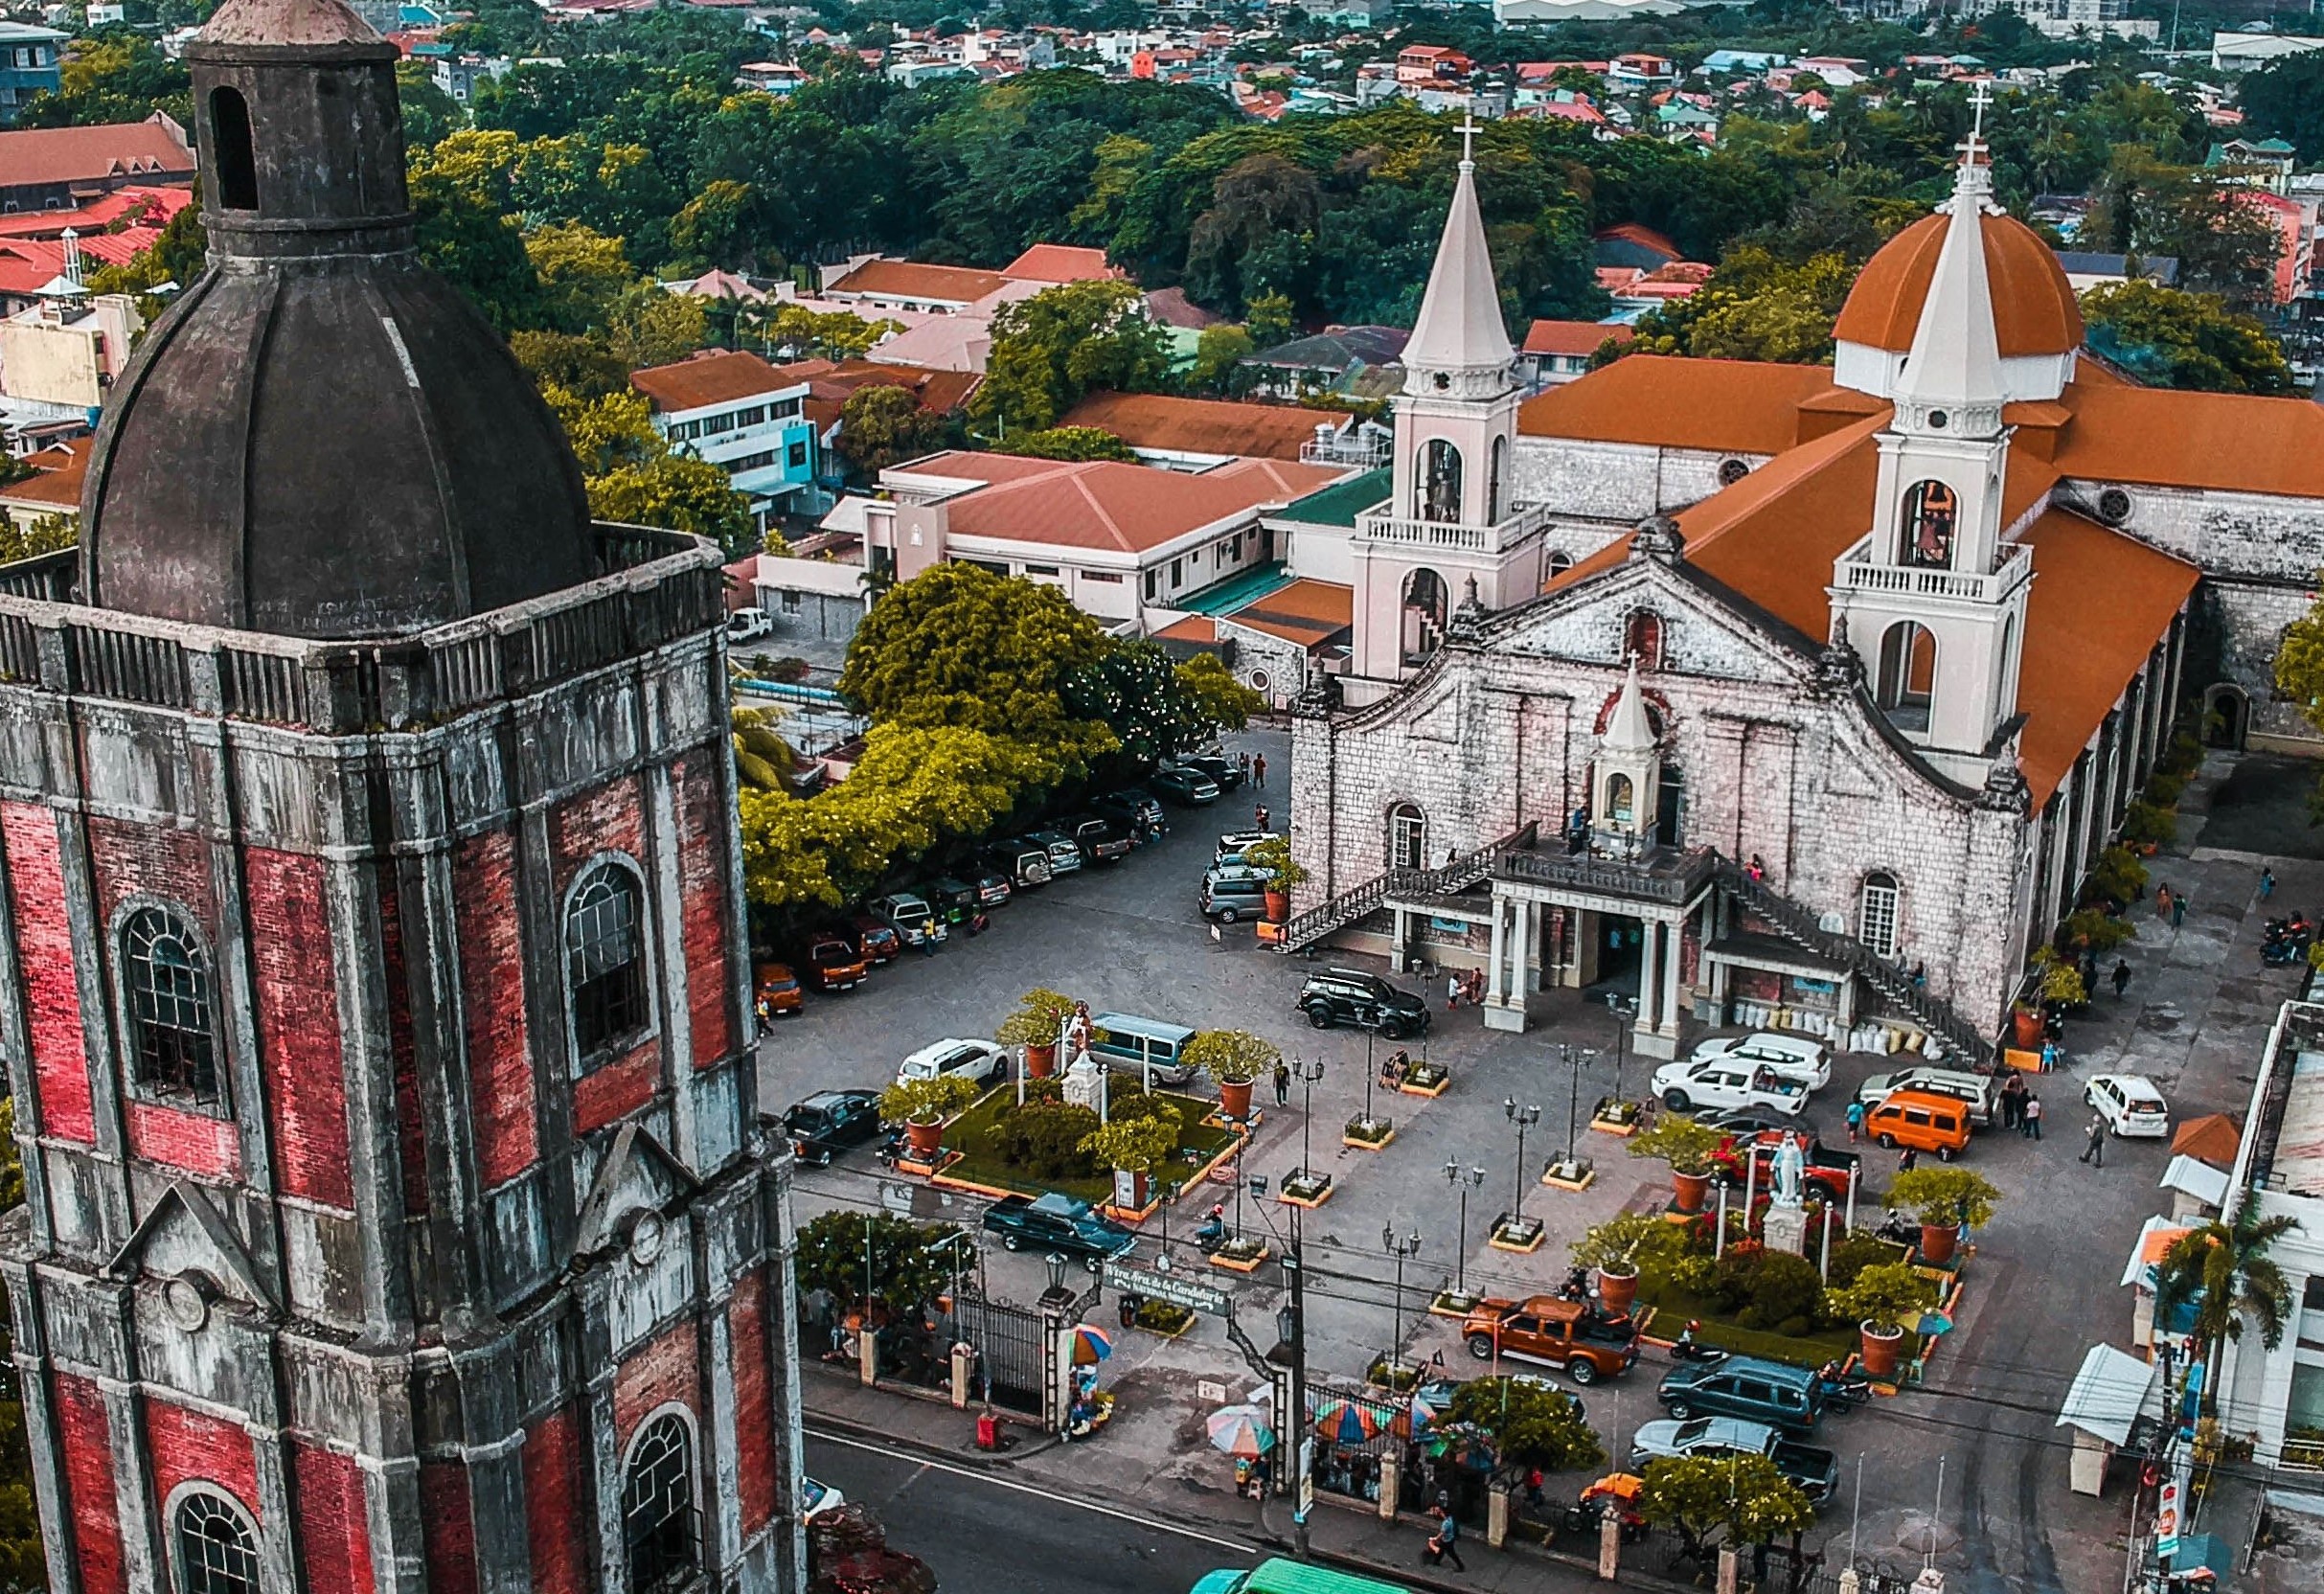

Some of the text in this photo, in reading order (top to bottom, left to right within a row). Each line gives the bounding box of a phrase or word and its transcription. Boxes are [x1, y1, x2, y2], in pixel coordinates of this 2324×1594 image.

[1151, 1277, 1161, 1288] de
[1162, 1280, 1172, 1291] la
[1172, 1282, 1224, 1305] Candelaria
